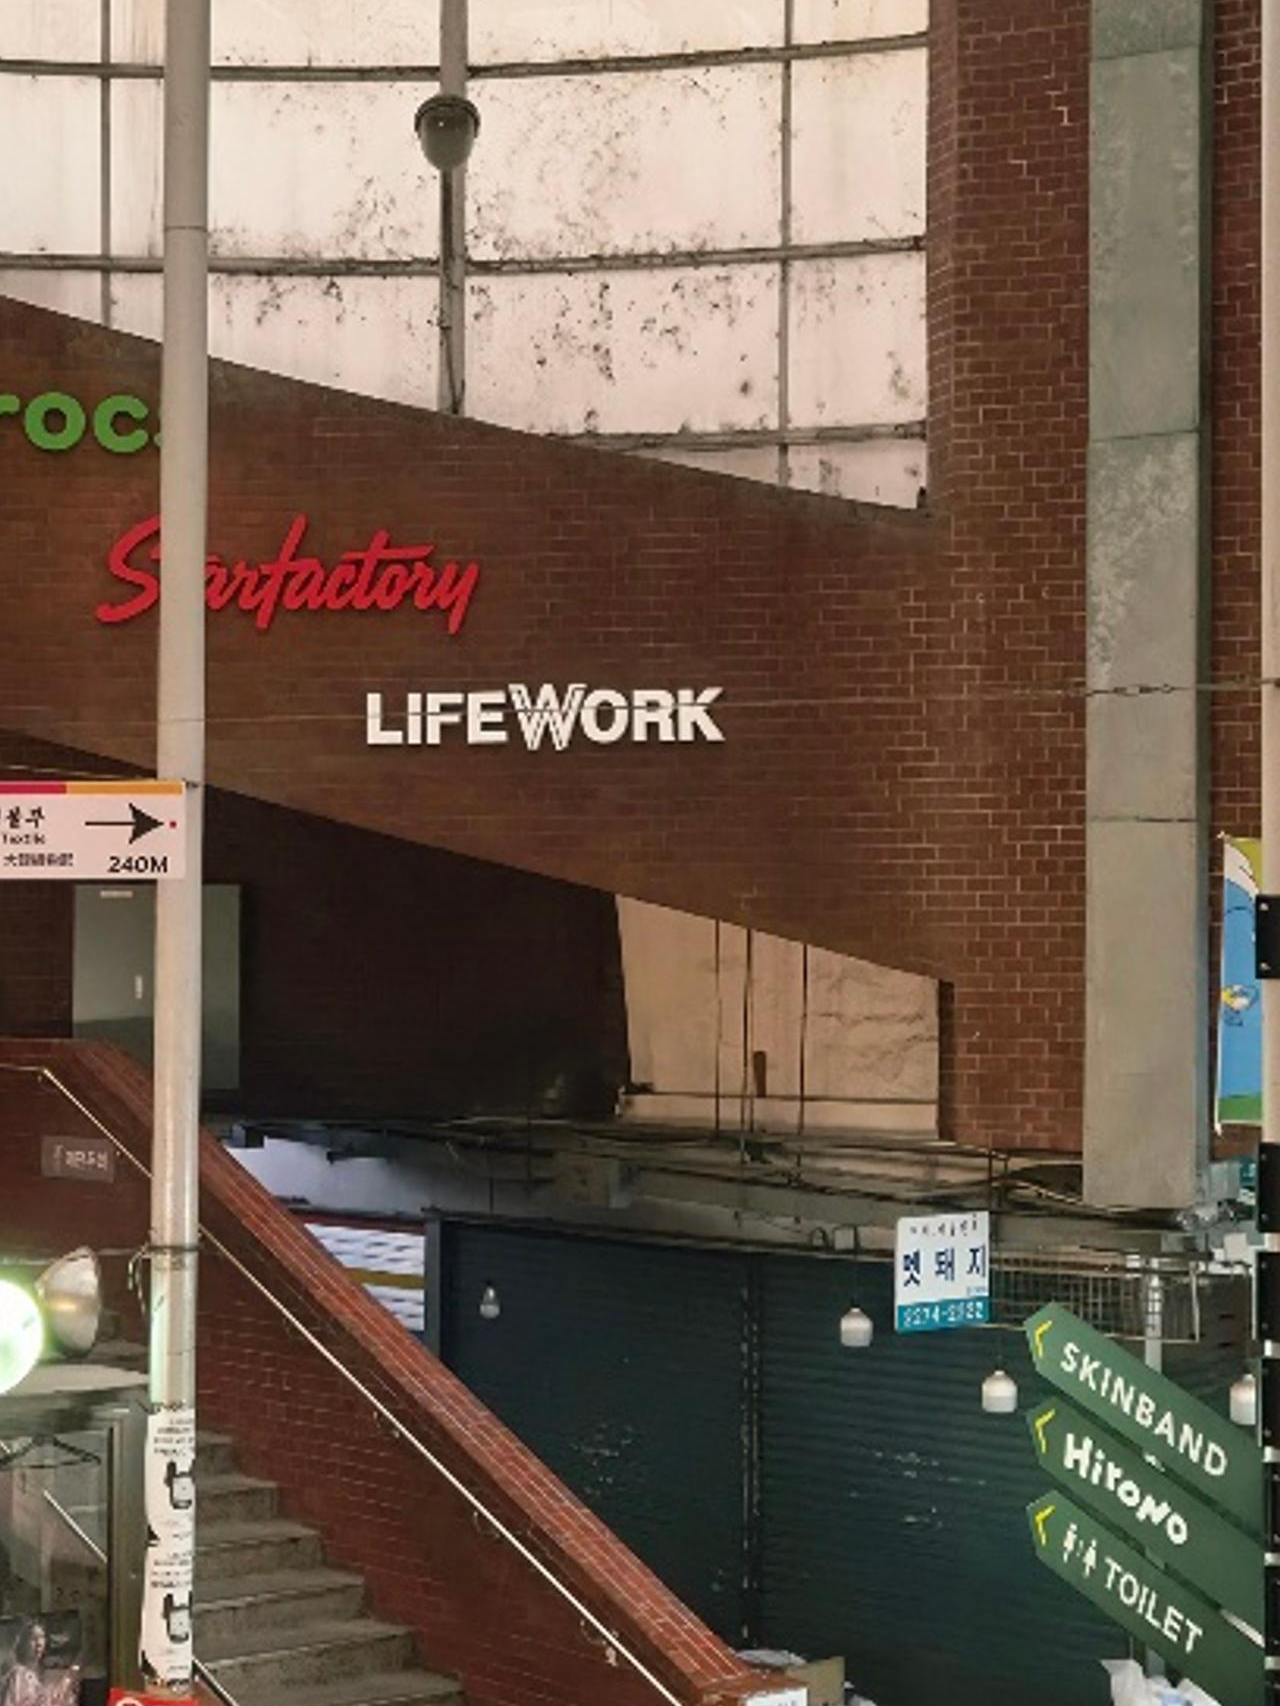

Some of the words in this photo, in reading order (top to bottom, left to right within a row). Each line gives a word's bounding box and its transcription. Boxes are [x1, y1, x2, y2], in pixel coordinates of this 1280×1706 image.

[95, 513, 479, 634] Sarfactory
[366, 684, 724, 751] LIFEWORK
[107, 855, 169, 875] 240M
[1060, 1341, 1228, 1477] SKINBAND
[1104, 1557, 1203, 1654] TOILET
